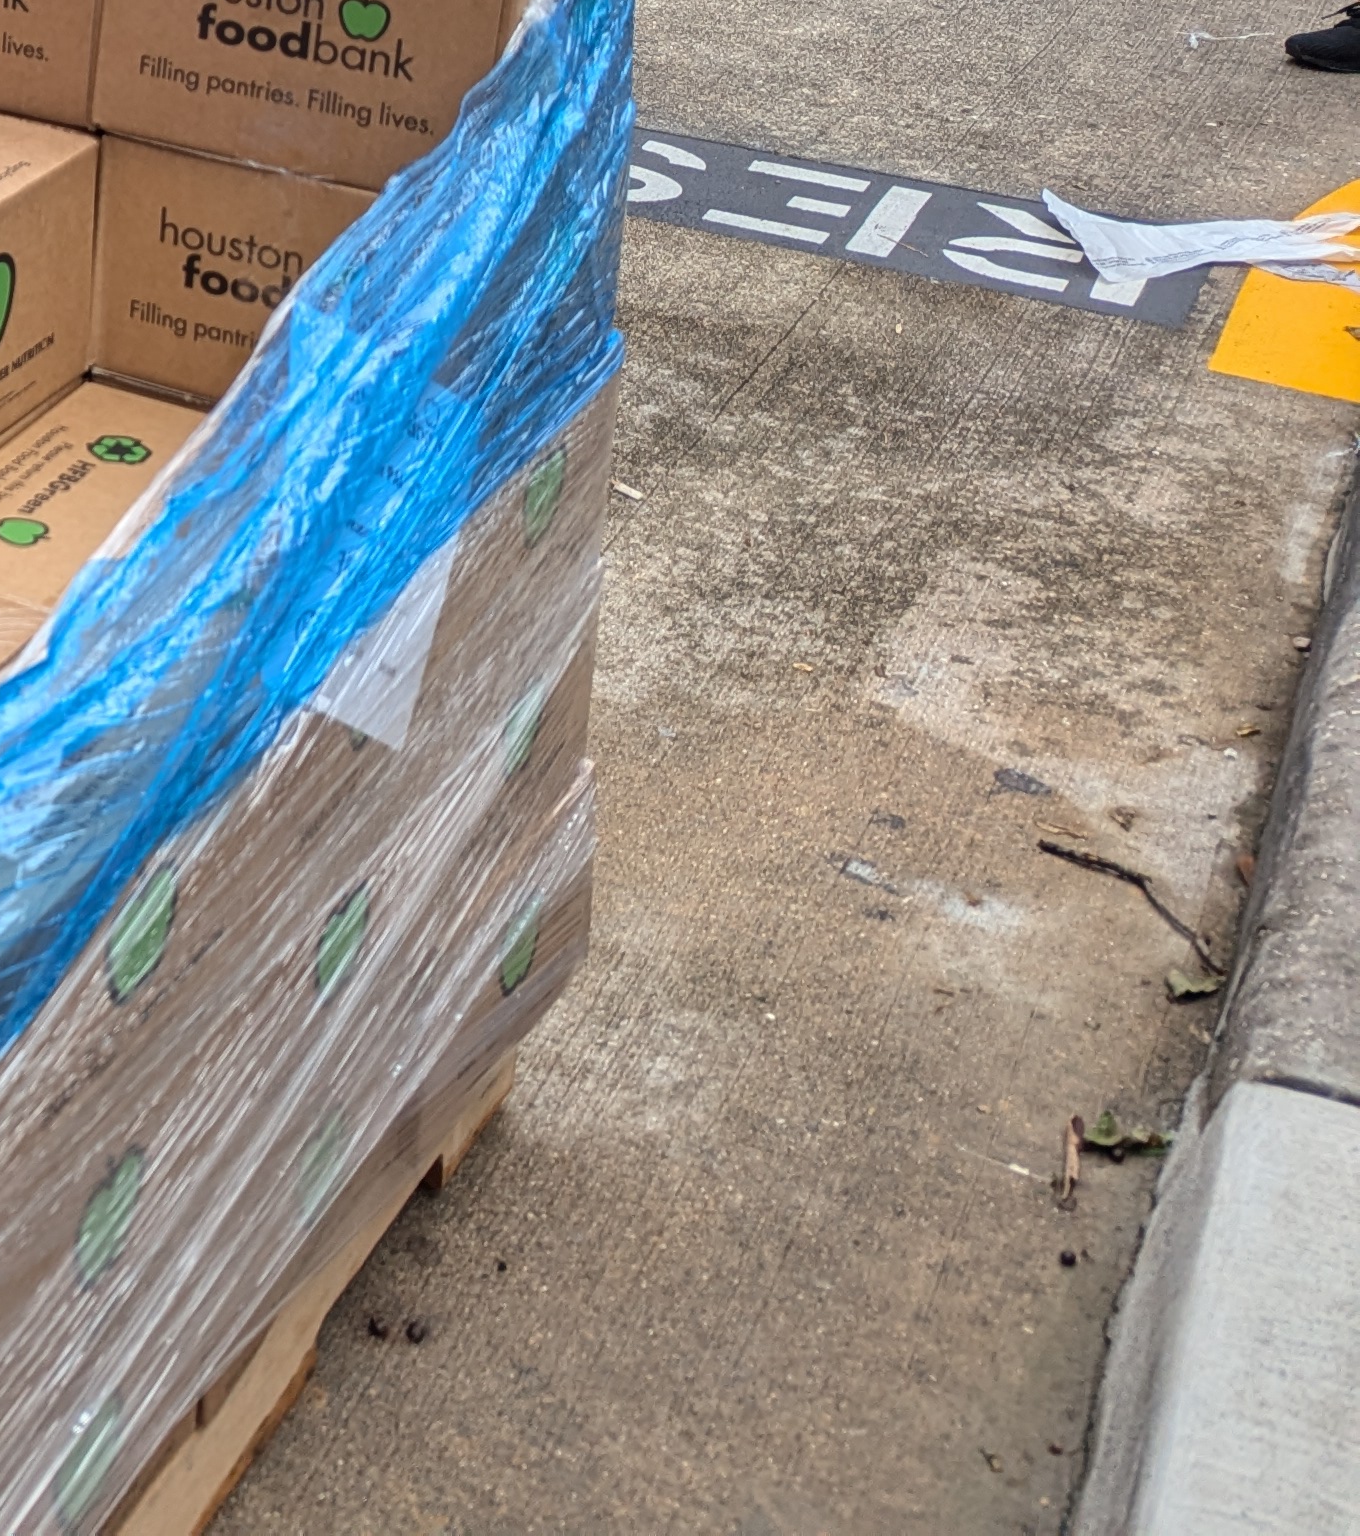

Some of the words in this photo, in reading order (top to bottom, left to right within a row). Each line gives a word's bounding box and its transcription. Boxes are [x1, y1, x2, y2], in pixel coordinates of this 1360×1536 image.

[1, 31, 49, 62] lives.
[197, 2, 413, 82] foodbank
[139, 54, 200, 93] Filling
[206, 75, 300, 108] pantries.
[307, 88, 372, 129] Filling
[378, 101, 434, 136] lives.
[159, 205, 303, 276] houston
[182, 253, 290, 309] food
[129, 299, 188, 338] Filling
[193, 322, 255, 348] pantri
